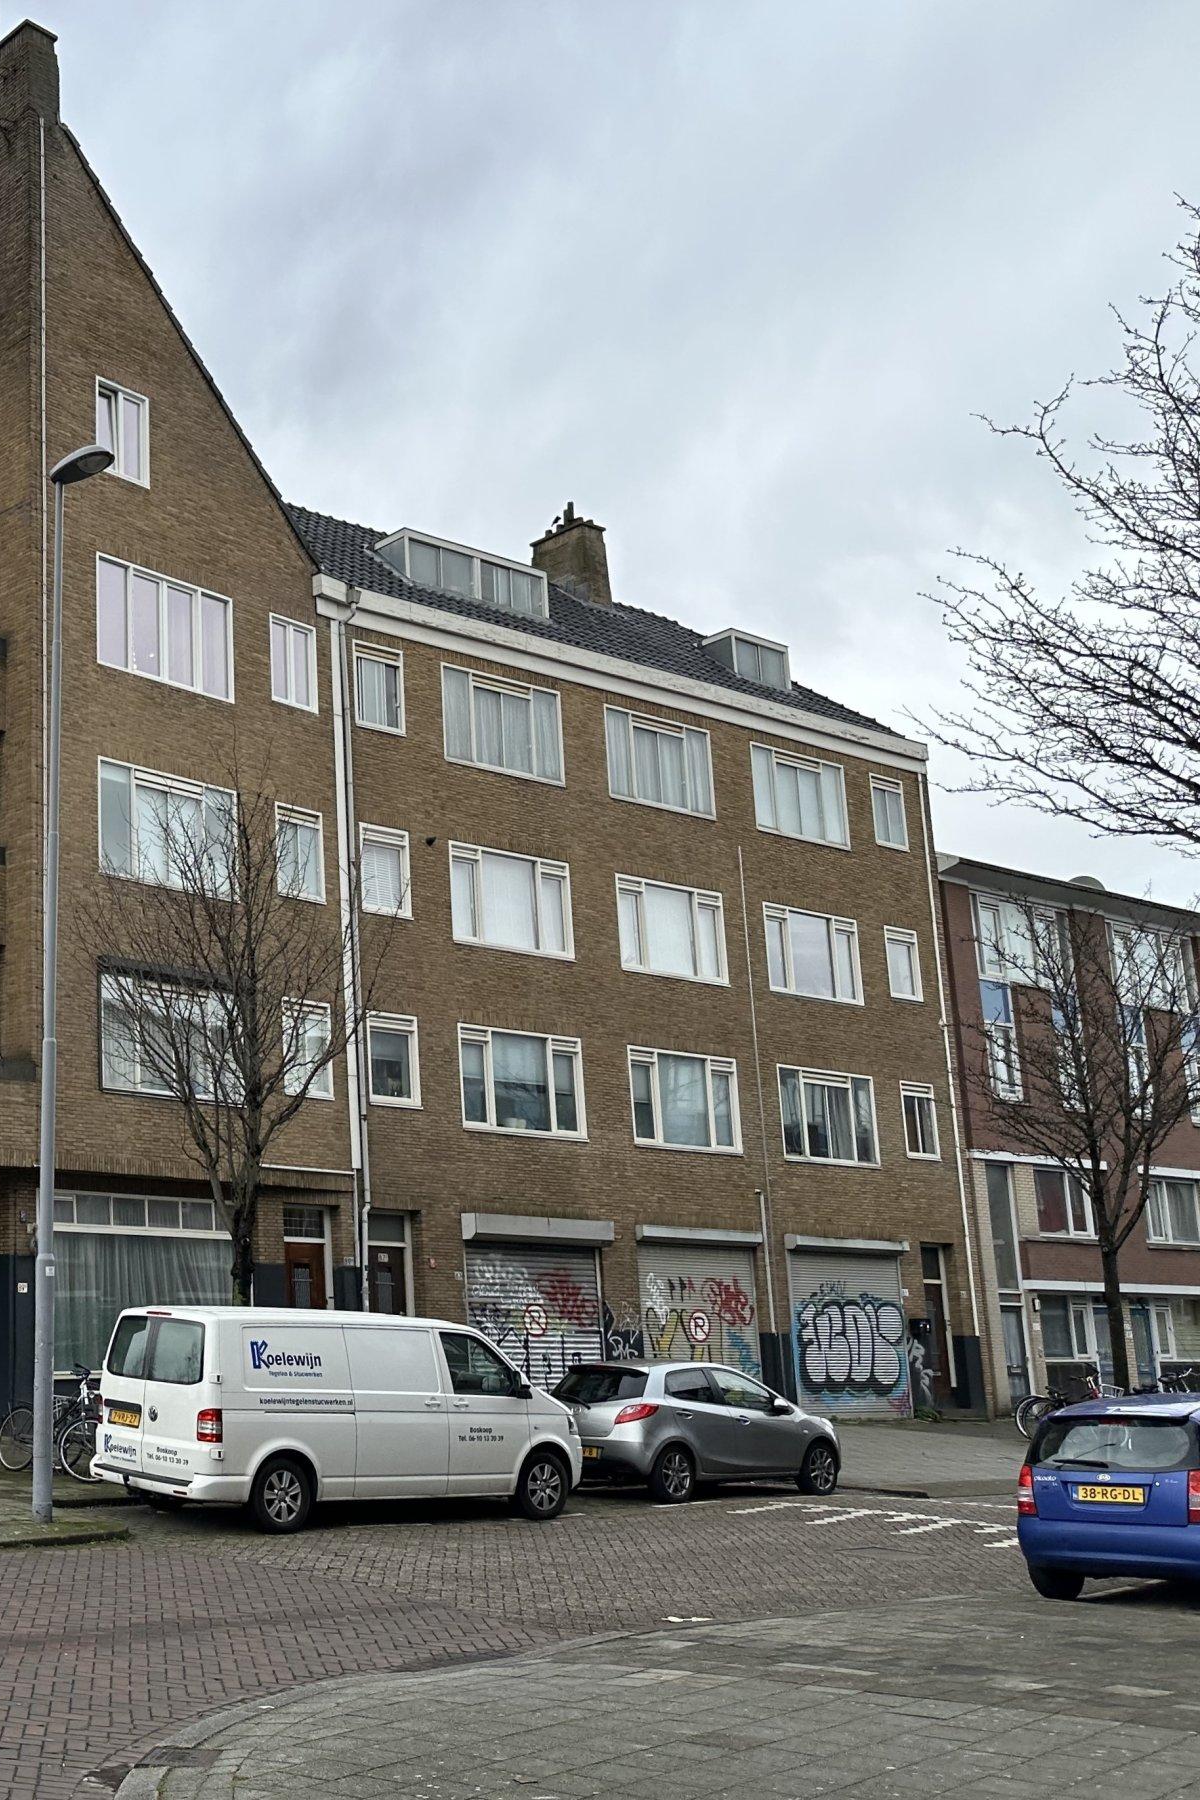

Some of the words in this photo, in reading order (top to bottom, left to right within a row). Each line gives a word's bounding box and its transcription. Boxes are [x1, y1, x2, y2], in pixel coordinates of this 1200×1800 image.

[250, 1340, 322, 1369] Koelewijn
[260, 1397, 353, 1406] koelewijntegelenstucwerken.nl
[104, 1433, 137, 1457] Koelewijn
[156, 1446, 178, 1456] Boskoop
[1081, 1487, 1140, 1501] 38-RG-DL
